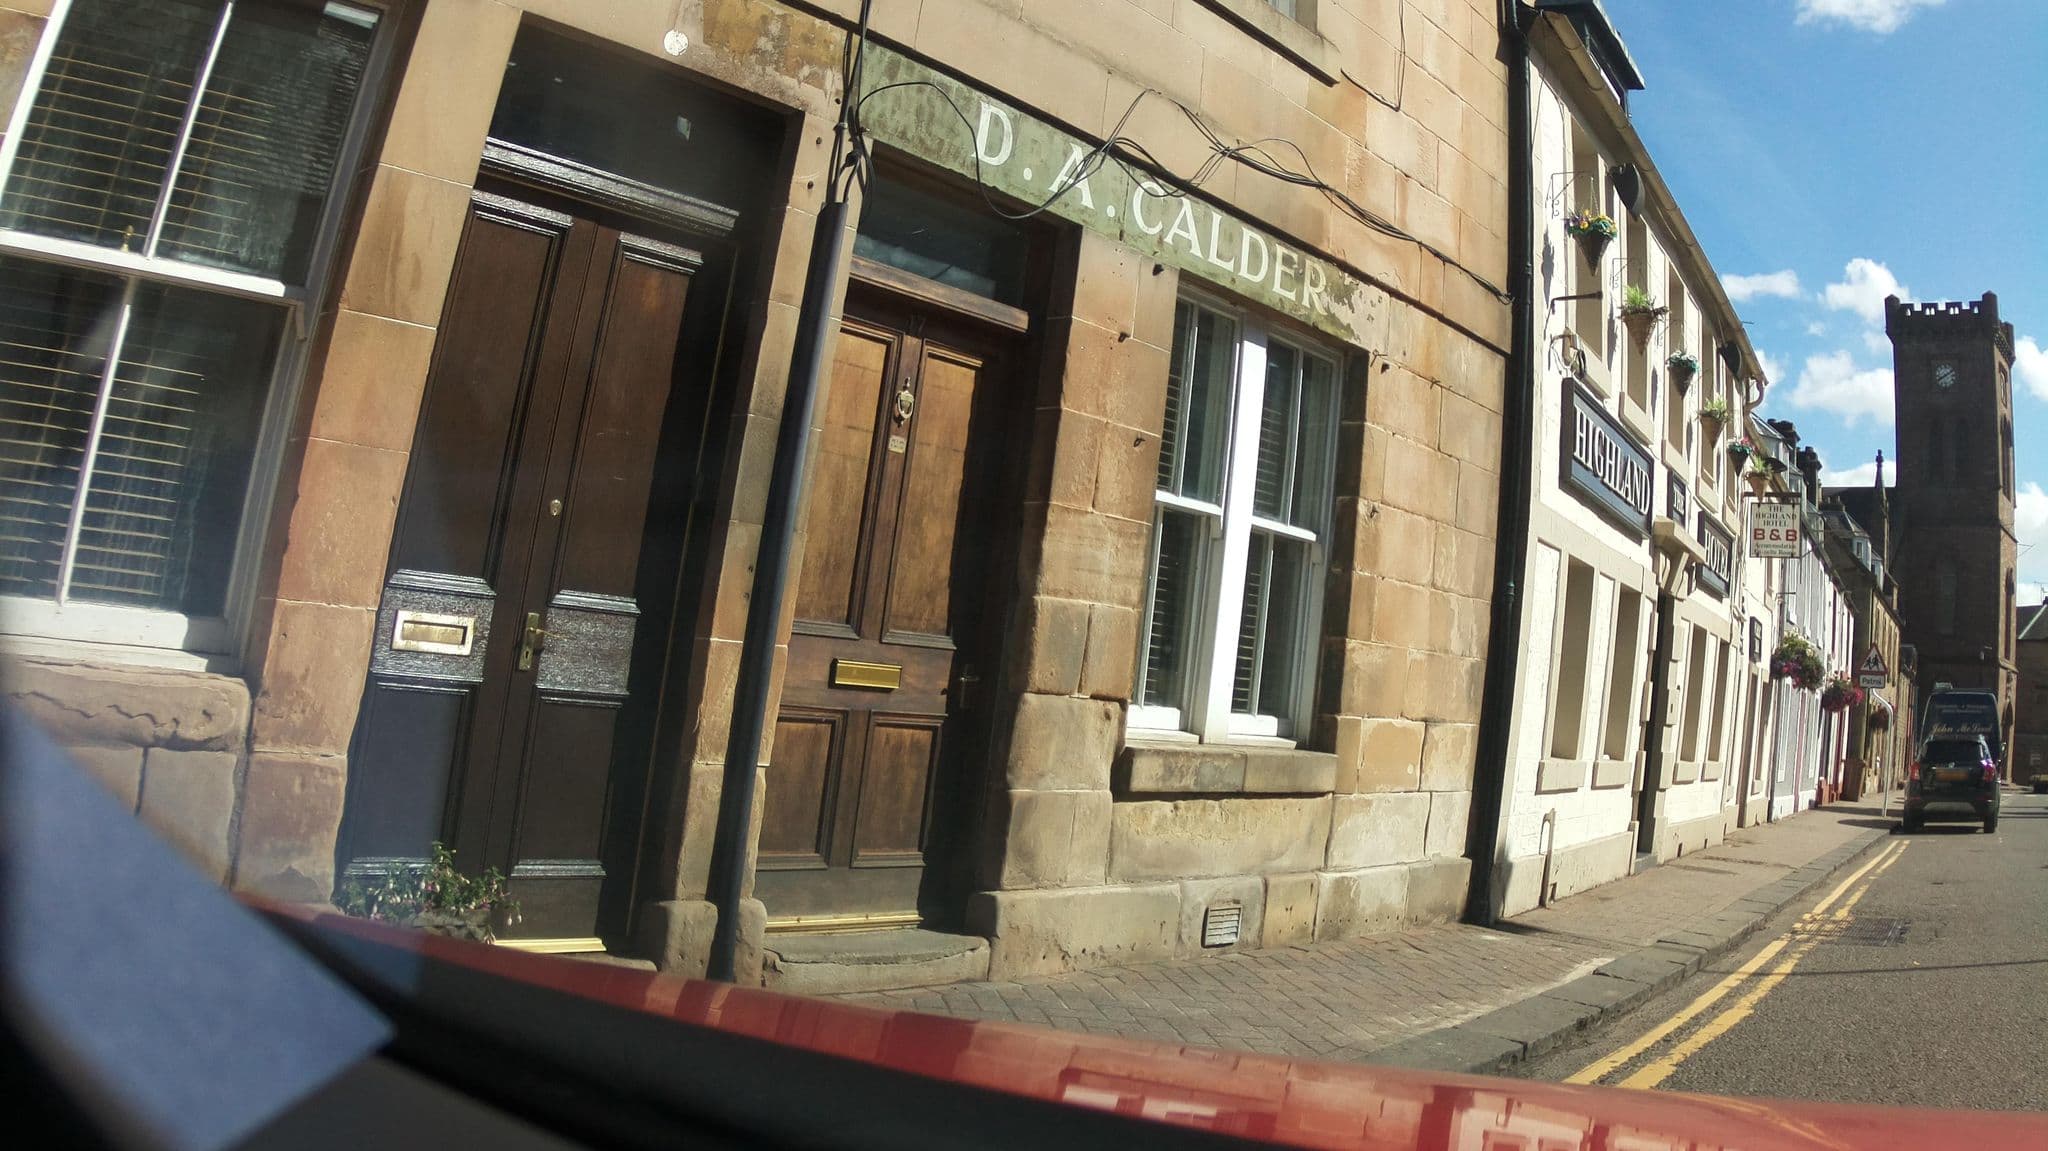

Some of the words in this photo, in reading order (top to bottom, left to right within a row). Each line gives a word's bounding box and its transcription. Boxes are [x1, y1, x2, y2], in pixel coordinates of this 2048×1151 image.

[1131, 178, 1333, 316] CALDER
[1573, 404, 1651, 516] HIGHLAND
[1704, 528, 1730, 582] HOTEL
[1862, 677, 1882, 685] Patrol
